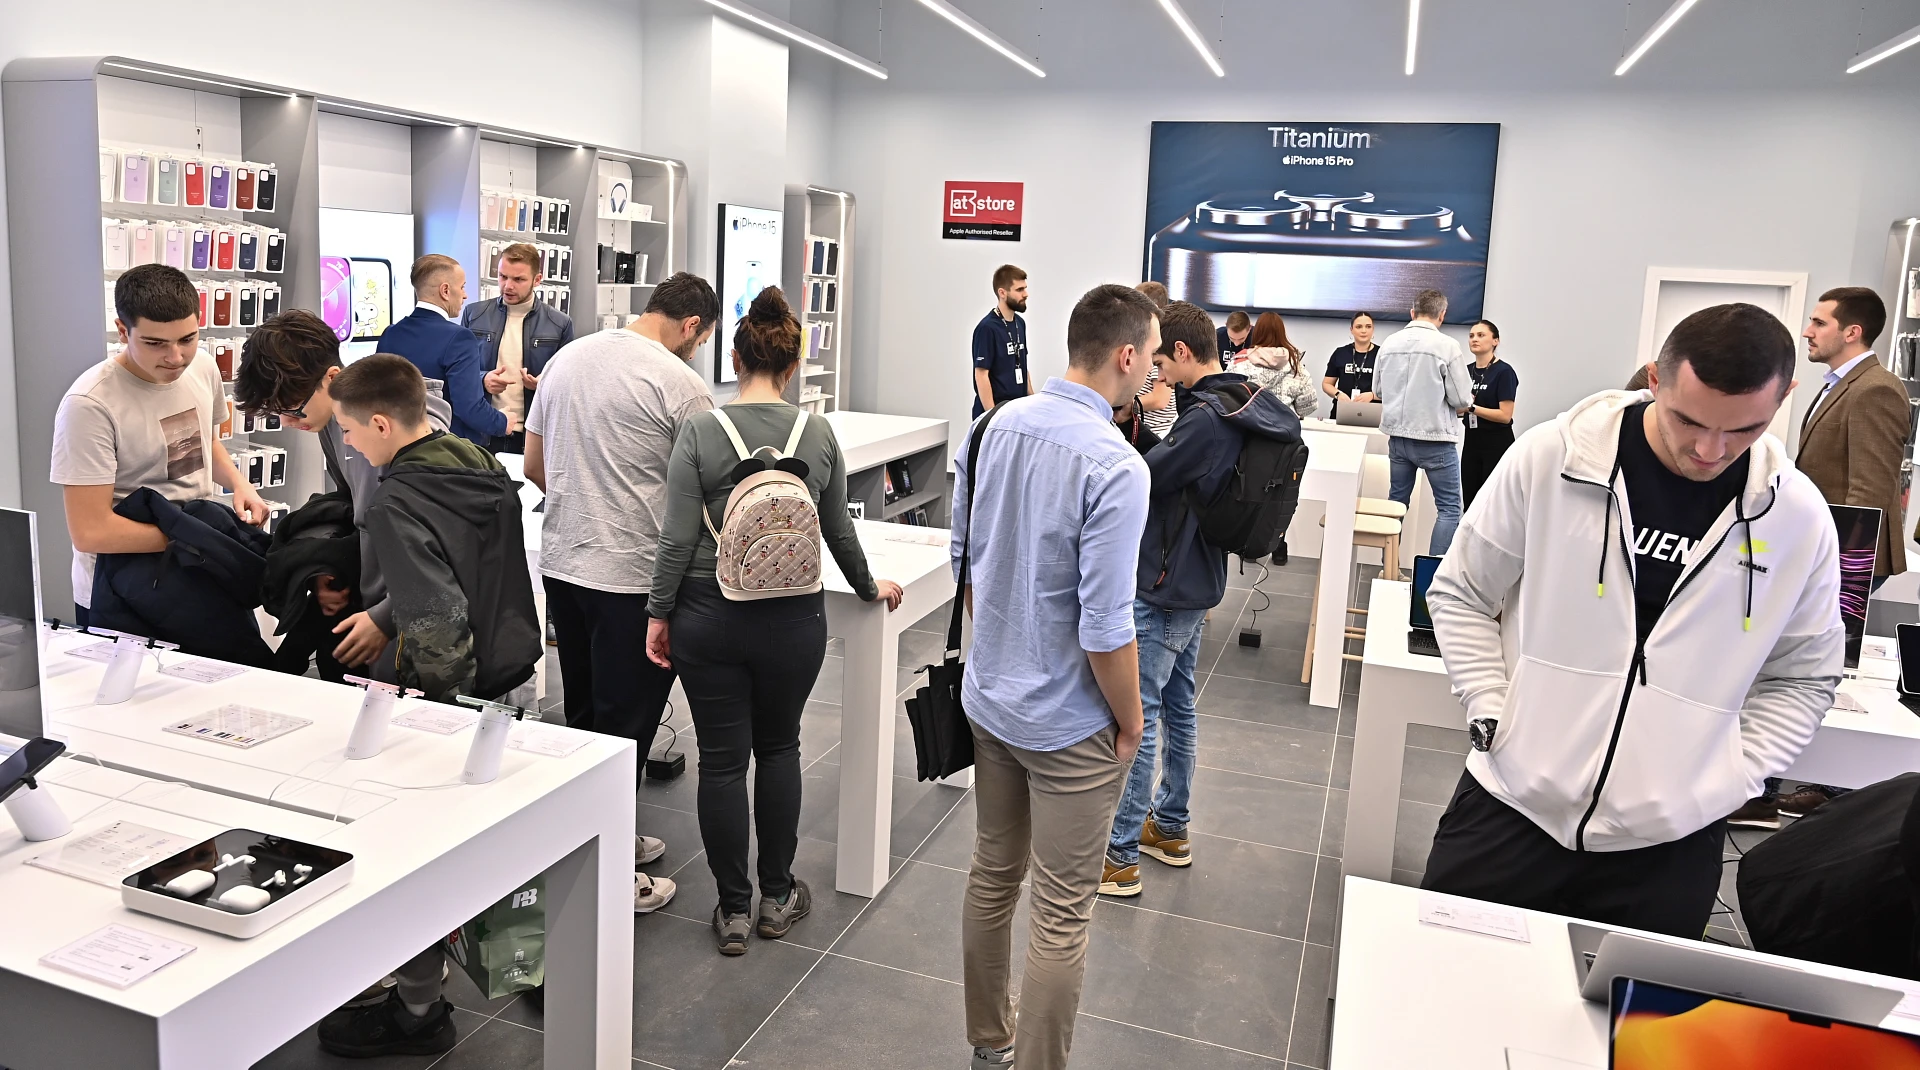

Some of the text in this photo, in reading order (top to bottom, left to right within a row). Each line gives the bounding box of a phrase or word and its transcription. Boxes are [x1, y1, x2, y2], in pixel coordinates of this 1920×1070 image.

[1267, 127, 1370, 149] Titanium
[1290, 155, 1354, 166] iPhone 15 Pro
[976, 195, 1015, 211] store
[739, 217, 767, 230] iPhone
[949, 227, 964, 235] Apple
[965, 228, 992, 236] Authorised
